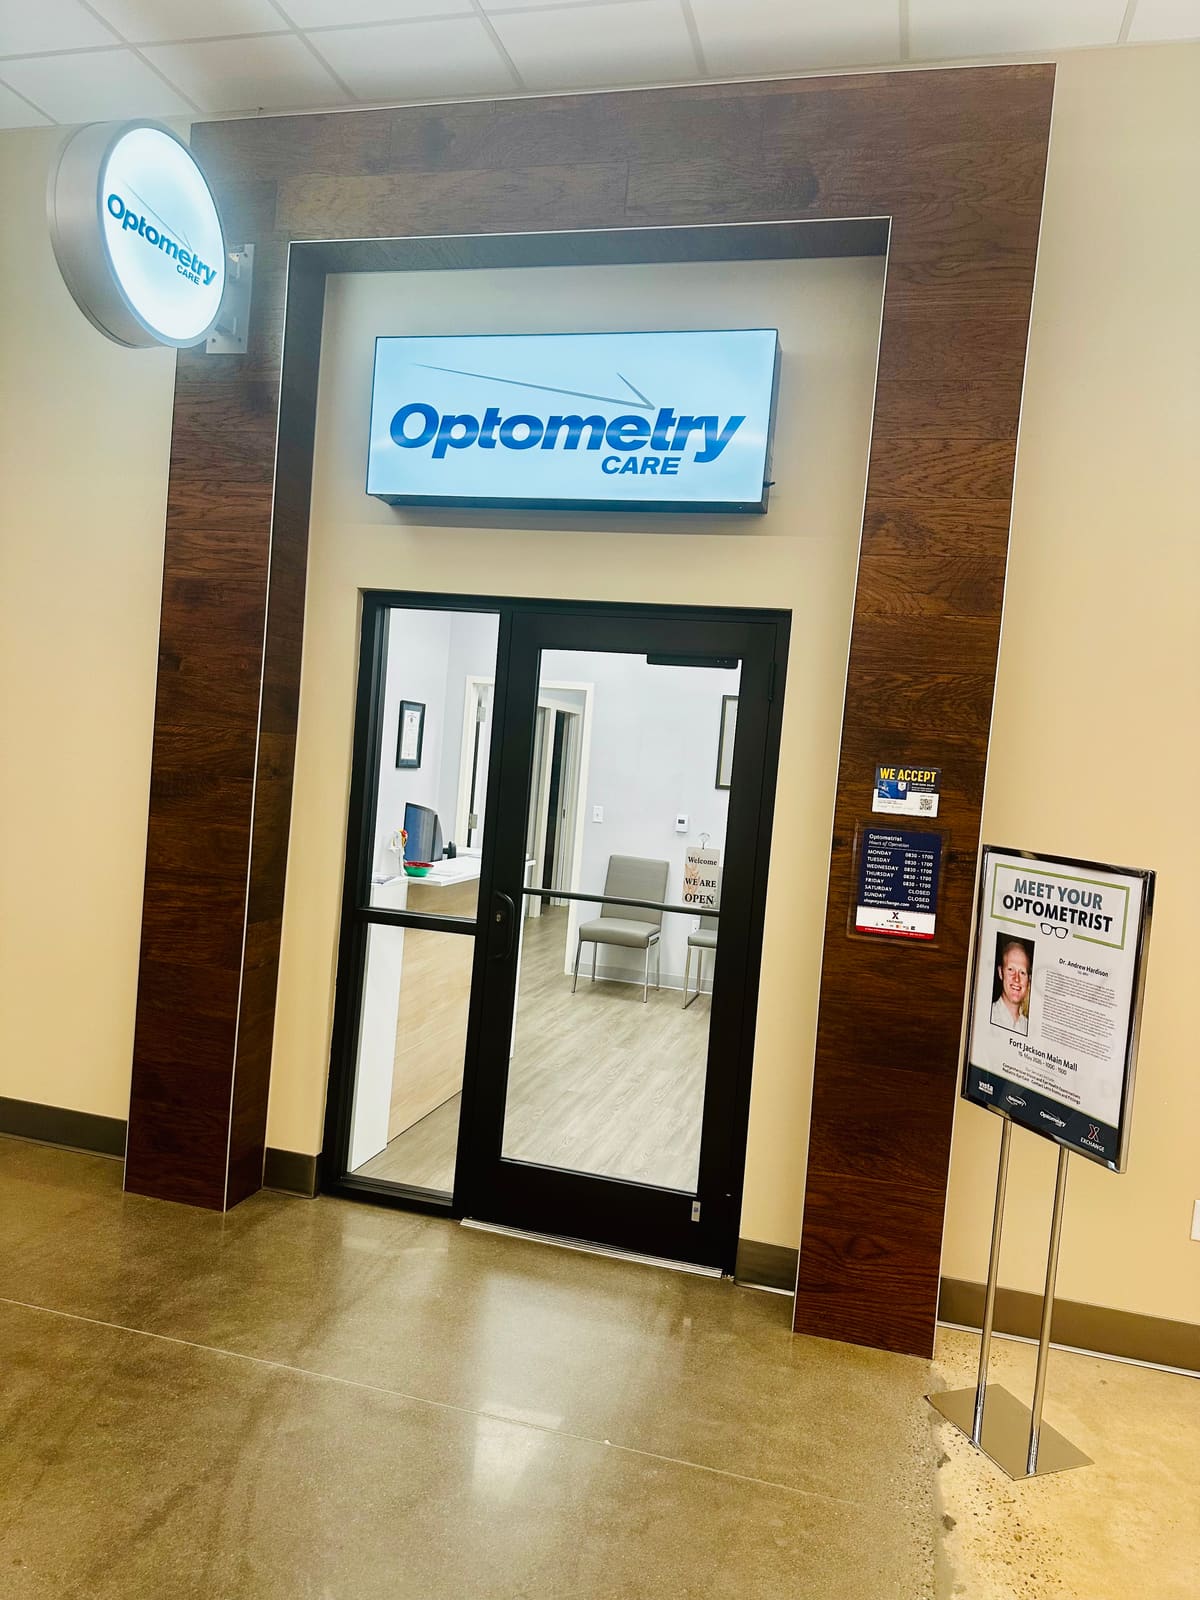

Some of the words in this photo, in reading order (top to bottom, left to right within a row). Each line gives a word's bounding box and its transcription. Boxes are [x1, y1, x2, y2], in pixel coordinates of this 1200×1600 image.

[107, 193, 217, 286] Optometry
[176, 264, 200, 285] CARE
[389, 403, 747, 463] Optometry
[601, 456, 681, 475] CARE
[880, 768, 896, 780] WE
[897, 769, 936, 783] ACCEPT
[868, 833, 902, 842] Optometrist
[688, 856, 718, 866] Welcome
[685, 878, 698, 886] WE
[699, 879, 716, 888] ARE
[684, 893, 714, 905] OPEN
[1014, 878, 1054, 900] MEET
[1058, 886, 1102, 910] YOUR
[1003, 894, 1112, 932] OPTOMETRIST
[1068, 960, 1085, 970] Andrew
[1086, 966, 1108, 977] Hardison
[1010, 1038, 1022, 1049] Fort
[1022, 1044, 1046, 1058] Jackson
[1046, 1053, 1062, 1066] Main
[1063, 1060, 1078, 1072] Mall
[1080, 1137, 1104, 1152] EXCHANGE
